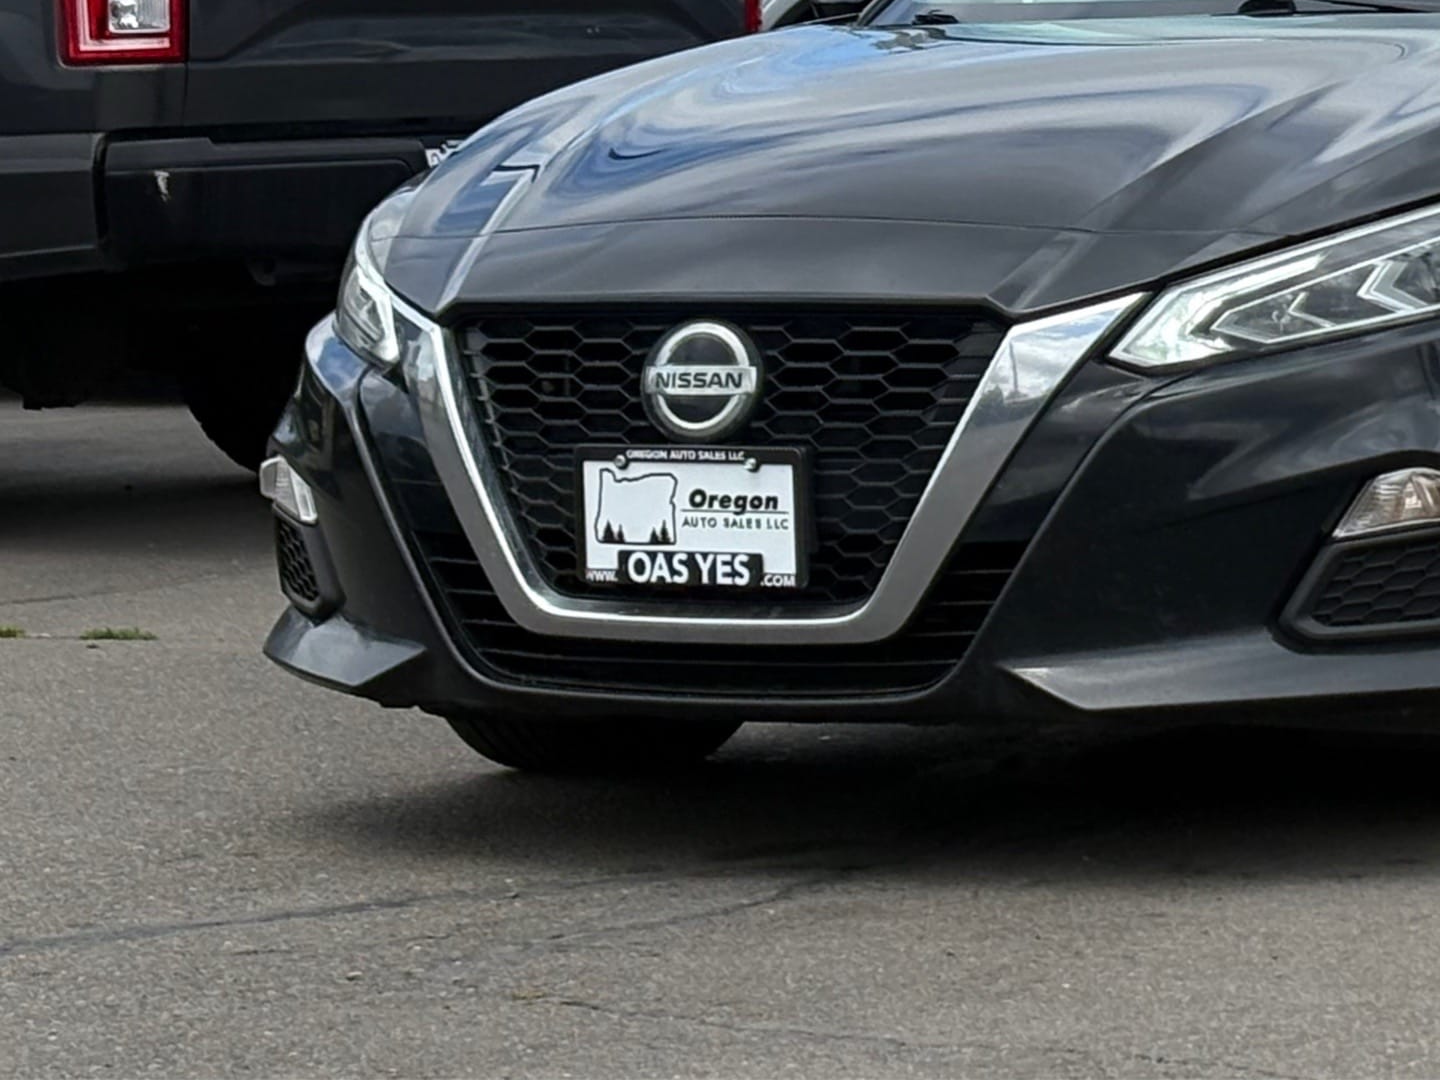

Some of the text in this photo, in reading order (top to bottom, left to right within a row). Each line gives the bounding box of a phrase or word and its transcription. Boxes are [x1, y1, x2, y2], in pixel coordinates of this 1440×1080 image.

[655, 372, 742, 389] NISSAN
[626, 449, 745, 461] OREGON AUTO SALES LLC
[689, 488, 779, 515] Oregon
[682, 516, 789, 530] AUTO SALES LLC
[627, 551, 689, 584] OAS
[694, 553, 750, 587] YES
